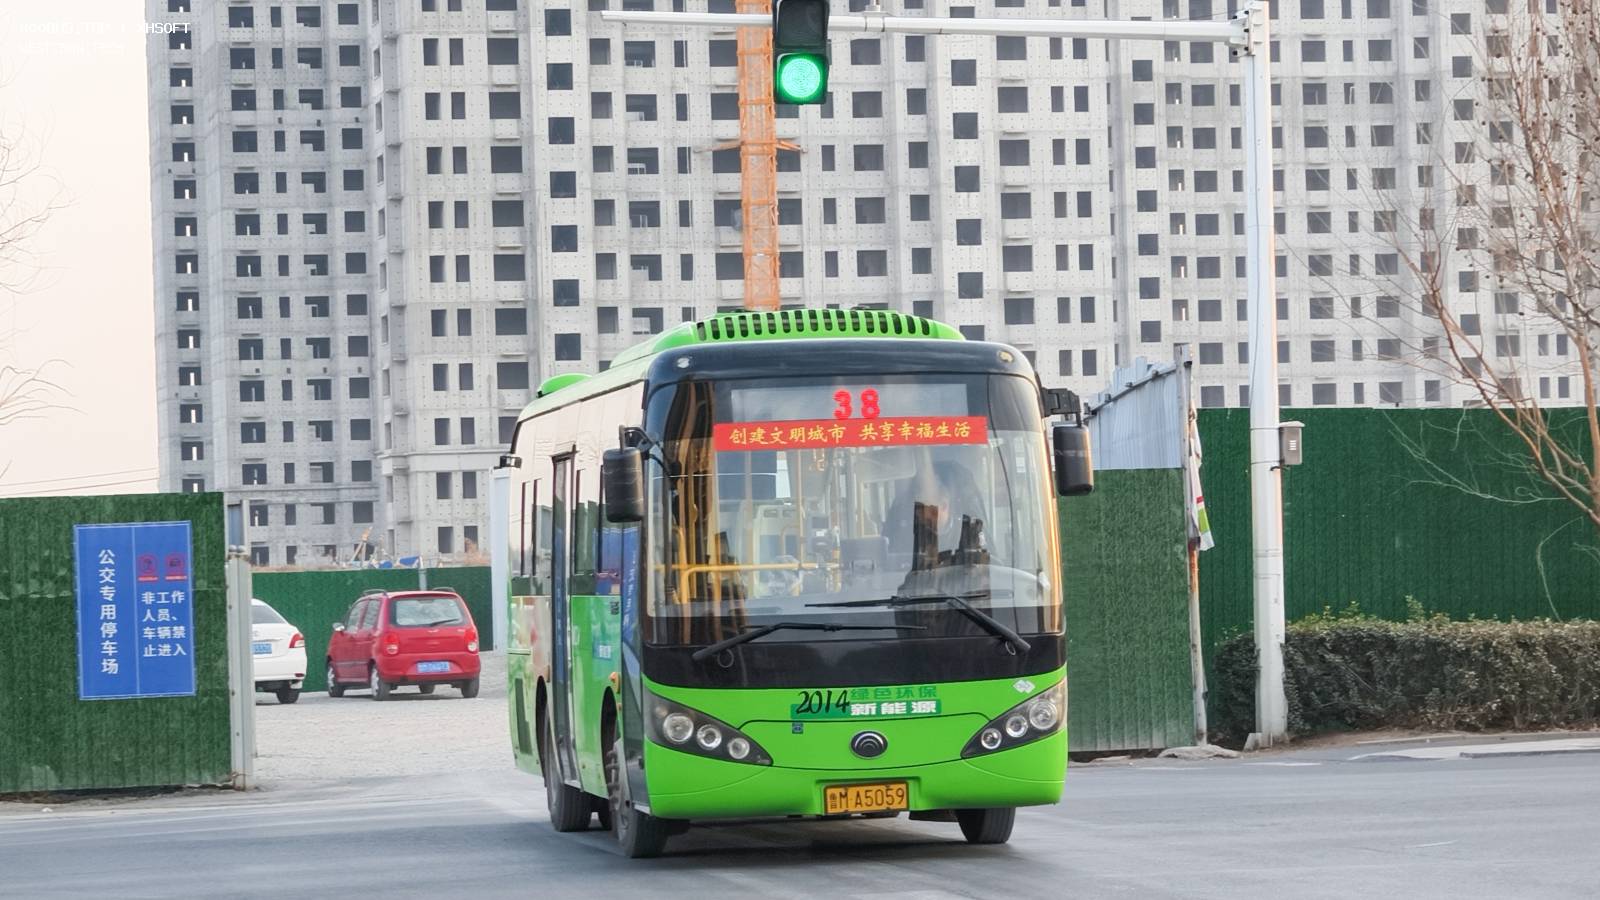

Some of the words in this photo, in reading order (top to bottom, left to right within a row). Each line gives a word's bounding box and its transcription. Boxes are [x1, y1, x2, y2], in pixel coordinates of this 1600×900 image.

[832, 389, 880, 419] 38
[729, 425, 847, 446] 创建文明城市
[858, 421, 971, 442] 共享幸福生活
[141, 591, 185, 605] 非工作
[98, 549, 119, 675] 公交专用停车场
[142, 626, 186, 640] 车辆禁
[143, 644, 187, 657] 止进入
[850, 685, 937, 699] 绿色环保
[795, 689, 850, 715] 2014
[850, 700, 937, 716] 新能源
